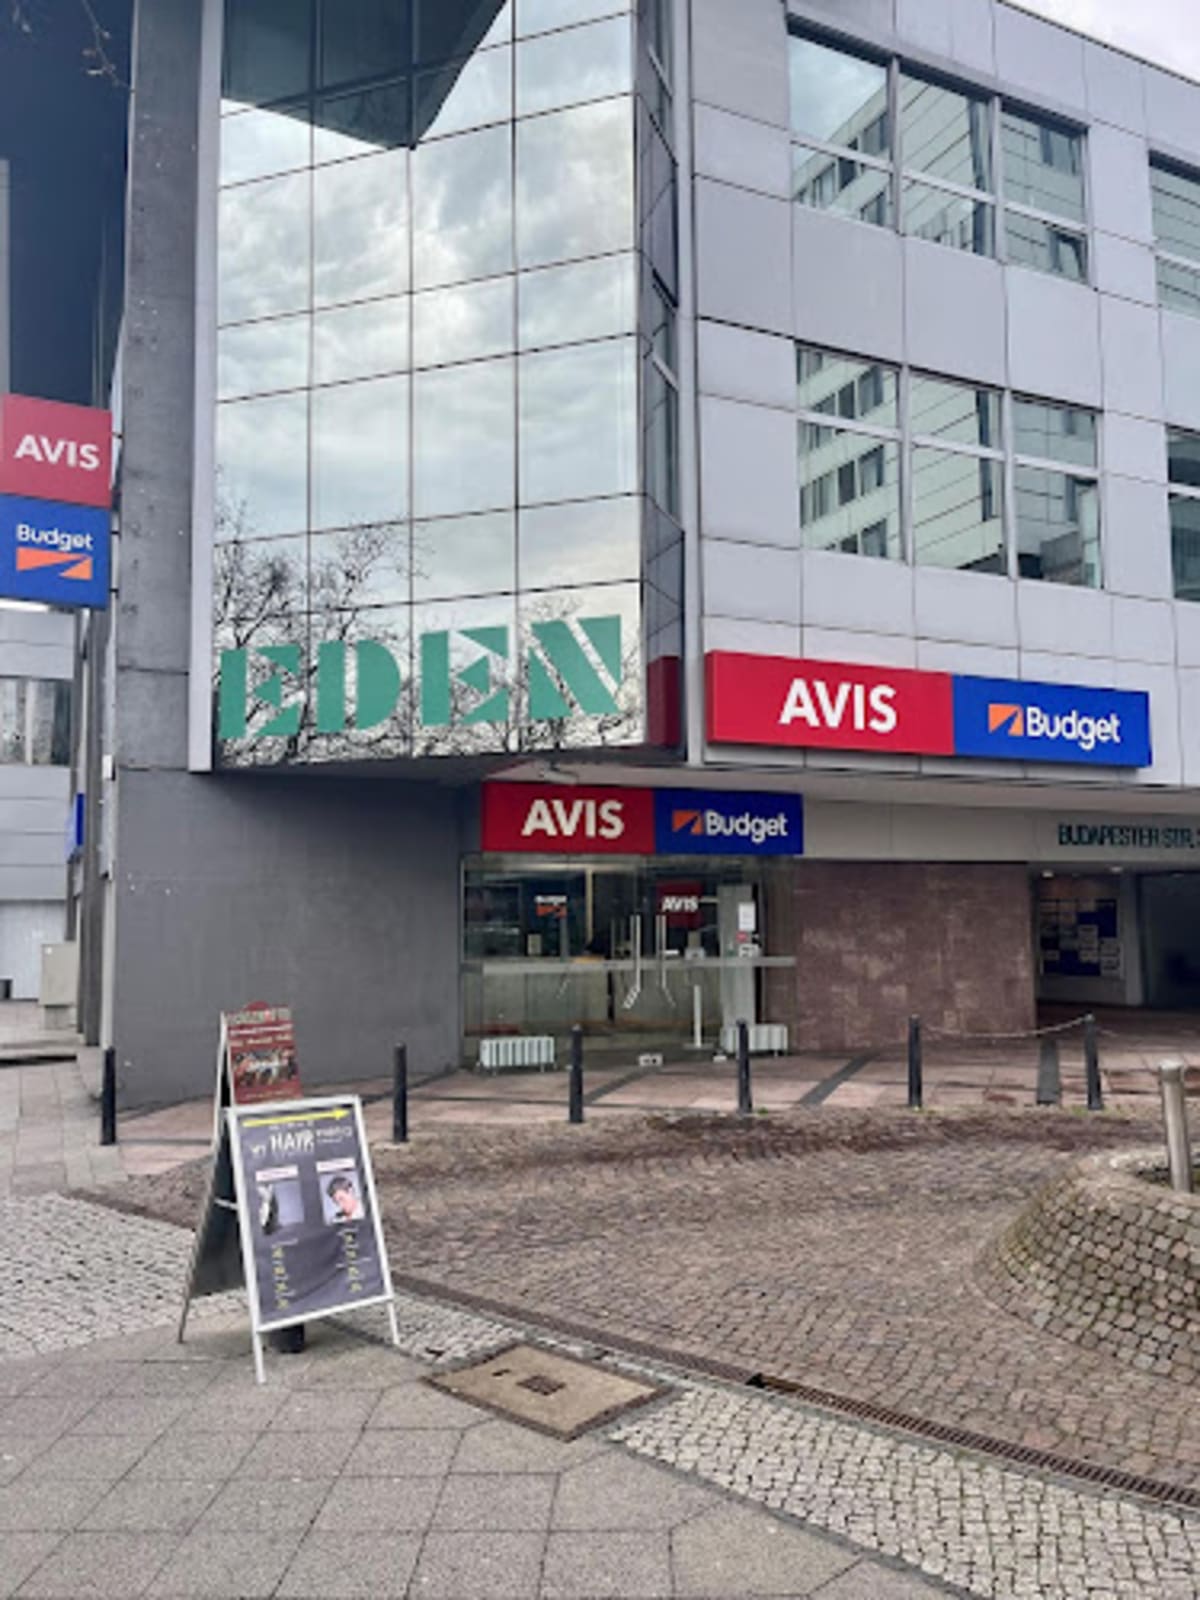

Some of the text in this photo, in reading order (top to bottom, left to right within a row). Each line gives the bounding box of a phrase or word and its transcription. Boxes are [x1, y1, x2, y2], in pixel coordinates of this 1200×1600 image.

[14, 434, 100, 470] AVIS
[16, 523, 93, 551] Budget
[218, 615, 622, 739] EDEN
[778, 678, 897, 733] AVIS
[1026, 706, 1121, 750] Budget
[521, 799, 624, 838] AVIS
[705, 810, 788, 843] Budget
[1058, 824, 1159, 849] BUDAPESTER
[662, 896, 699, 913] AVIS
